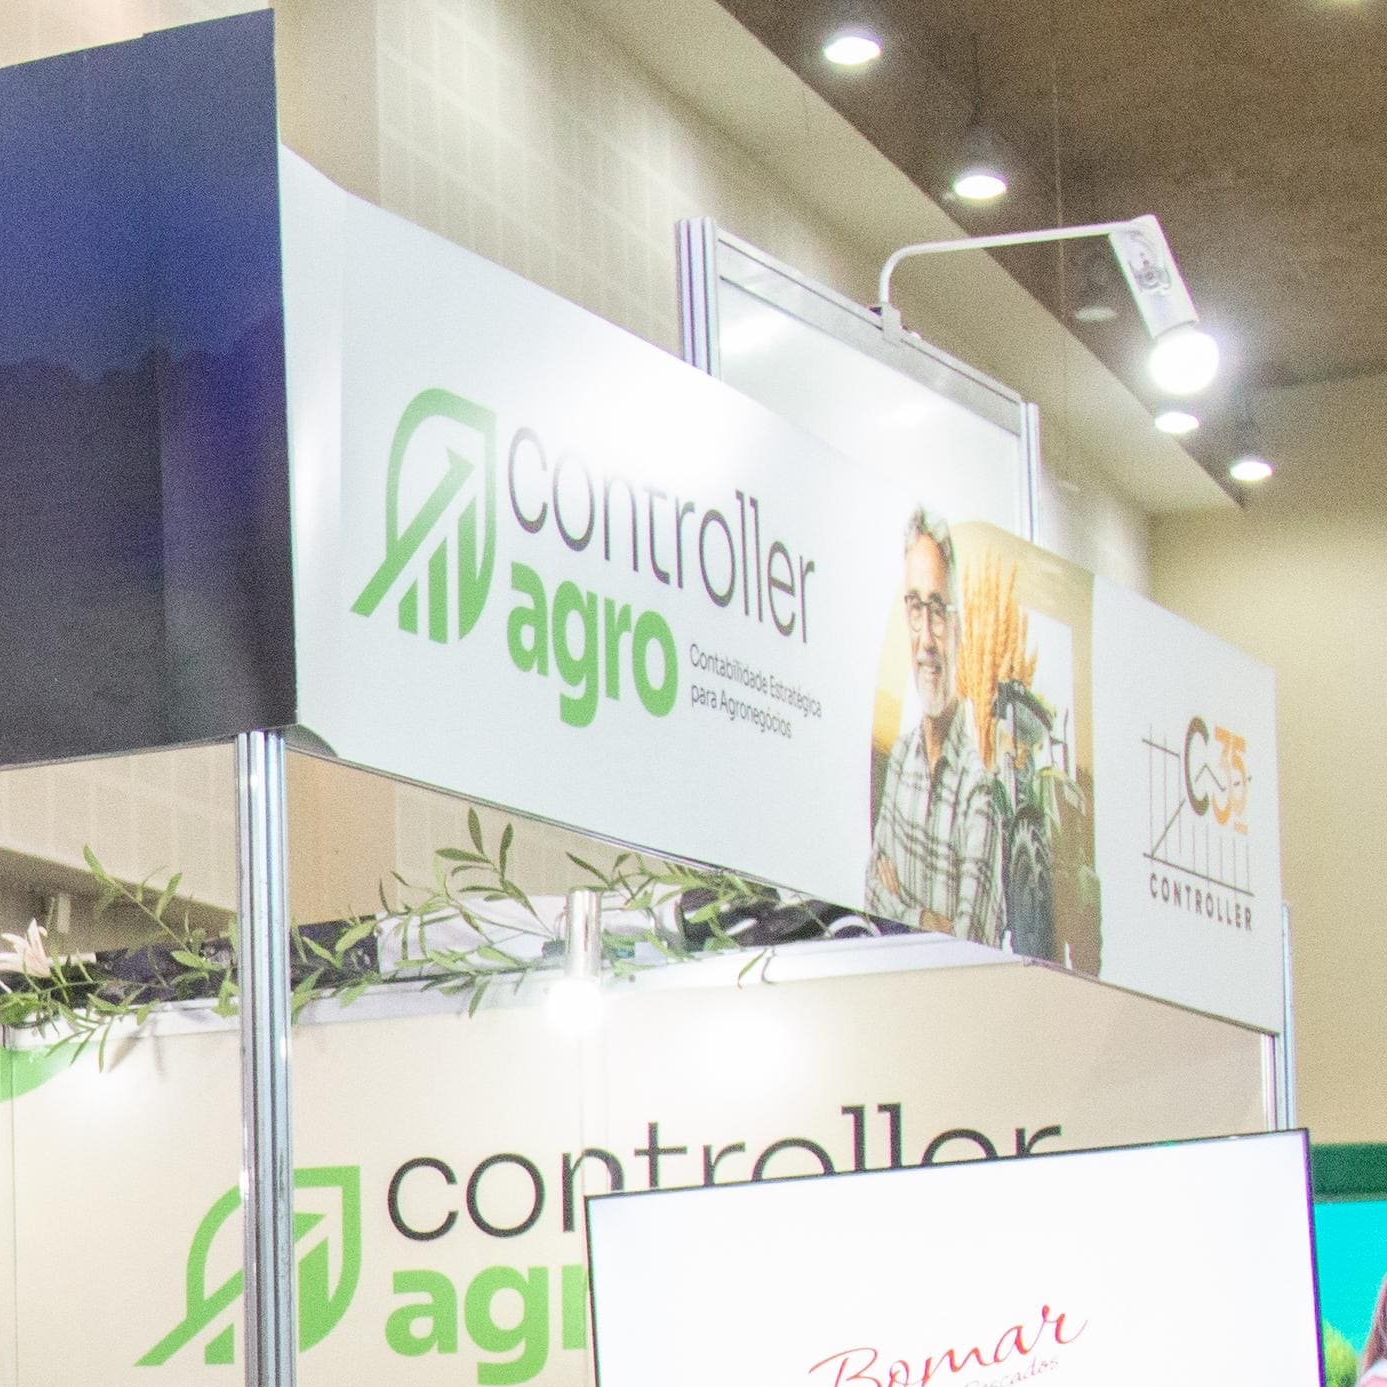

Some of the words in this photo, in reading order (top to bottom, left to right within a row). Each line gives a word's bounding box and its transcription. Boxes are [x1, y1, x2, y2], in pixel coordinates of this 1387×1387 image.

[508, 426, 815, 644] controller
[507, 562, 679, 728] agro
[690, 643, 768, 694] Contabilidade
[770, 675, 822, 718] Estratégica
[691, 685, 717, 708] para
[720, 690, 792, 738] Agronegócios
[1150, 872, 1253, 931] CONTROLLER
[385, 1264, 586, 1386] agr
